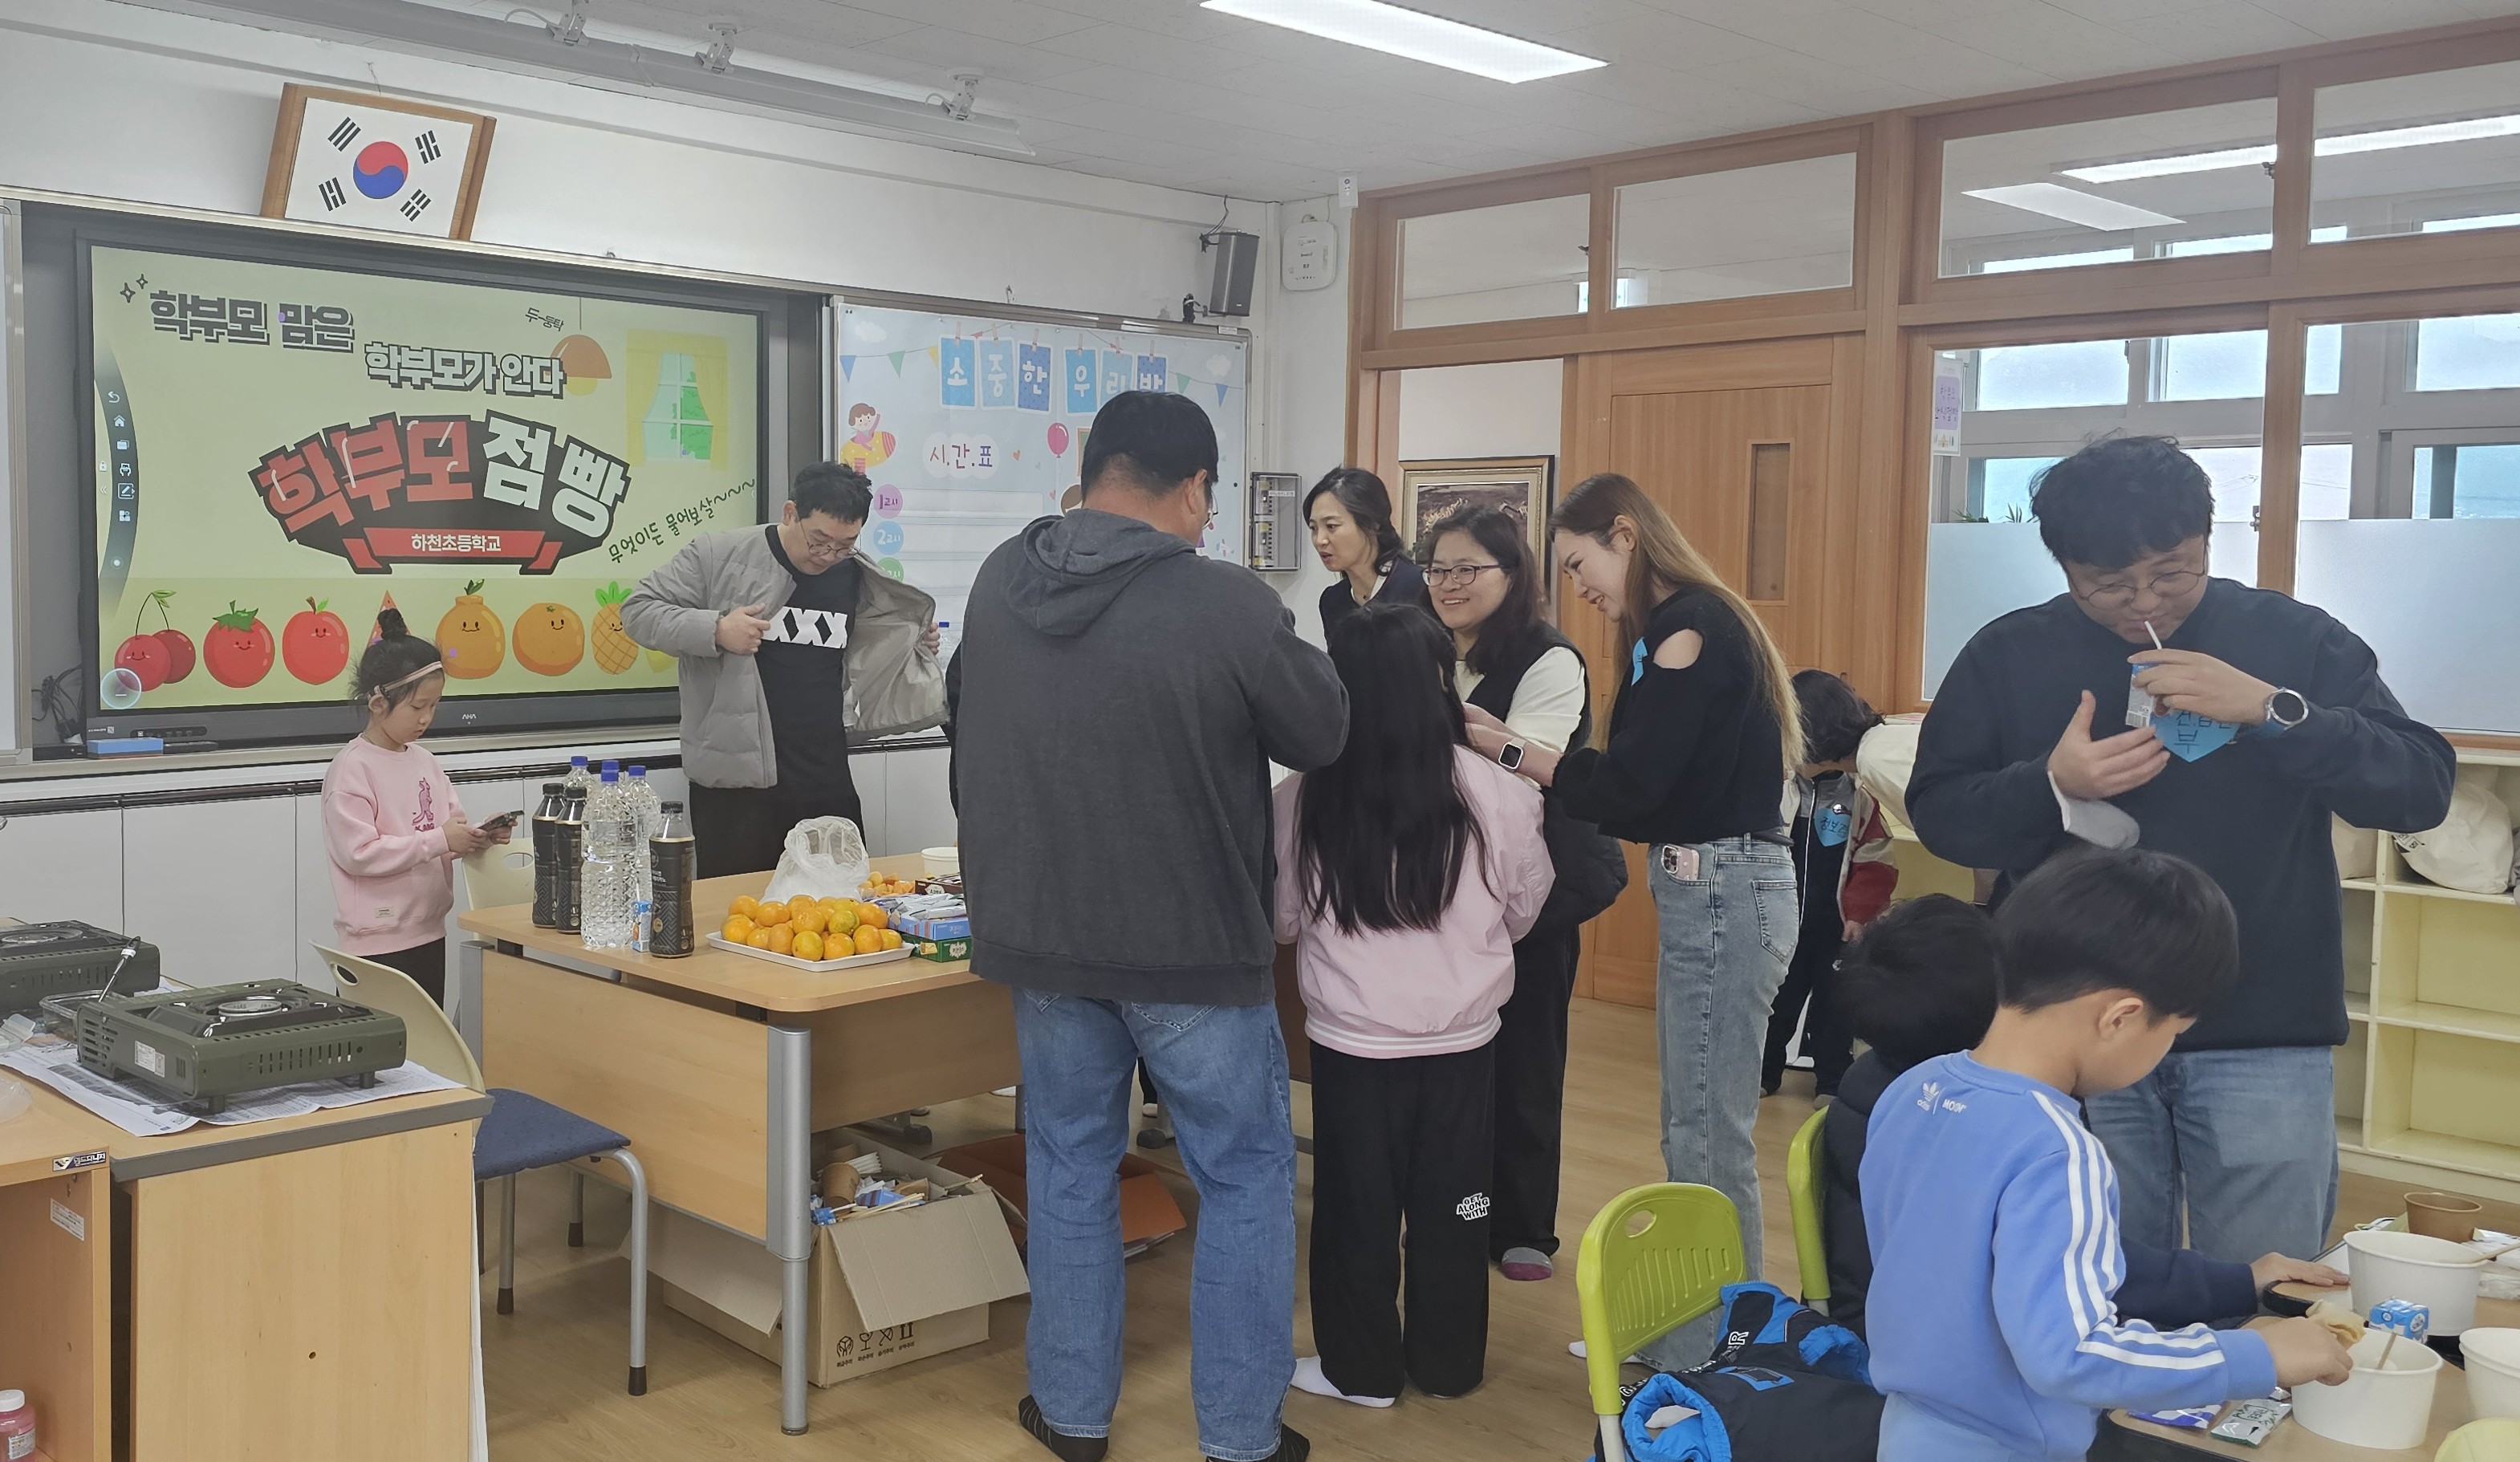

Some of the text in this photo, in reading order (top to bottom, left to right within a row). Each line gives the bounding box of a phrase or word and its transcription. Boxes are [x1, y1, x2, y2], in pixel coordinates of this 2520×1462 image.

[150, 290, 270, 347] 학부모
[364, 341, 567, 400] 학부모가 안다
[947, 356, 1048, 398] 소중한
[255, 417, 475, 534] 학부모
[879, 493, 898, 510] 1교시
[411, 533, 502, 552] 하천초등학교
[608, 522, 665, 563] 무엇이든
[877, 529, 900, 545] 2교시
[1457, 1196, 1490, 1214] ALONG
[1463, 1206, 1487, 1220] WITH
